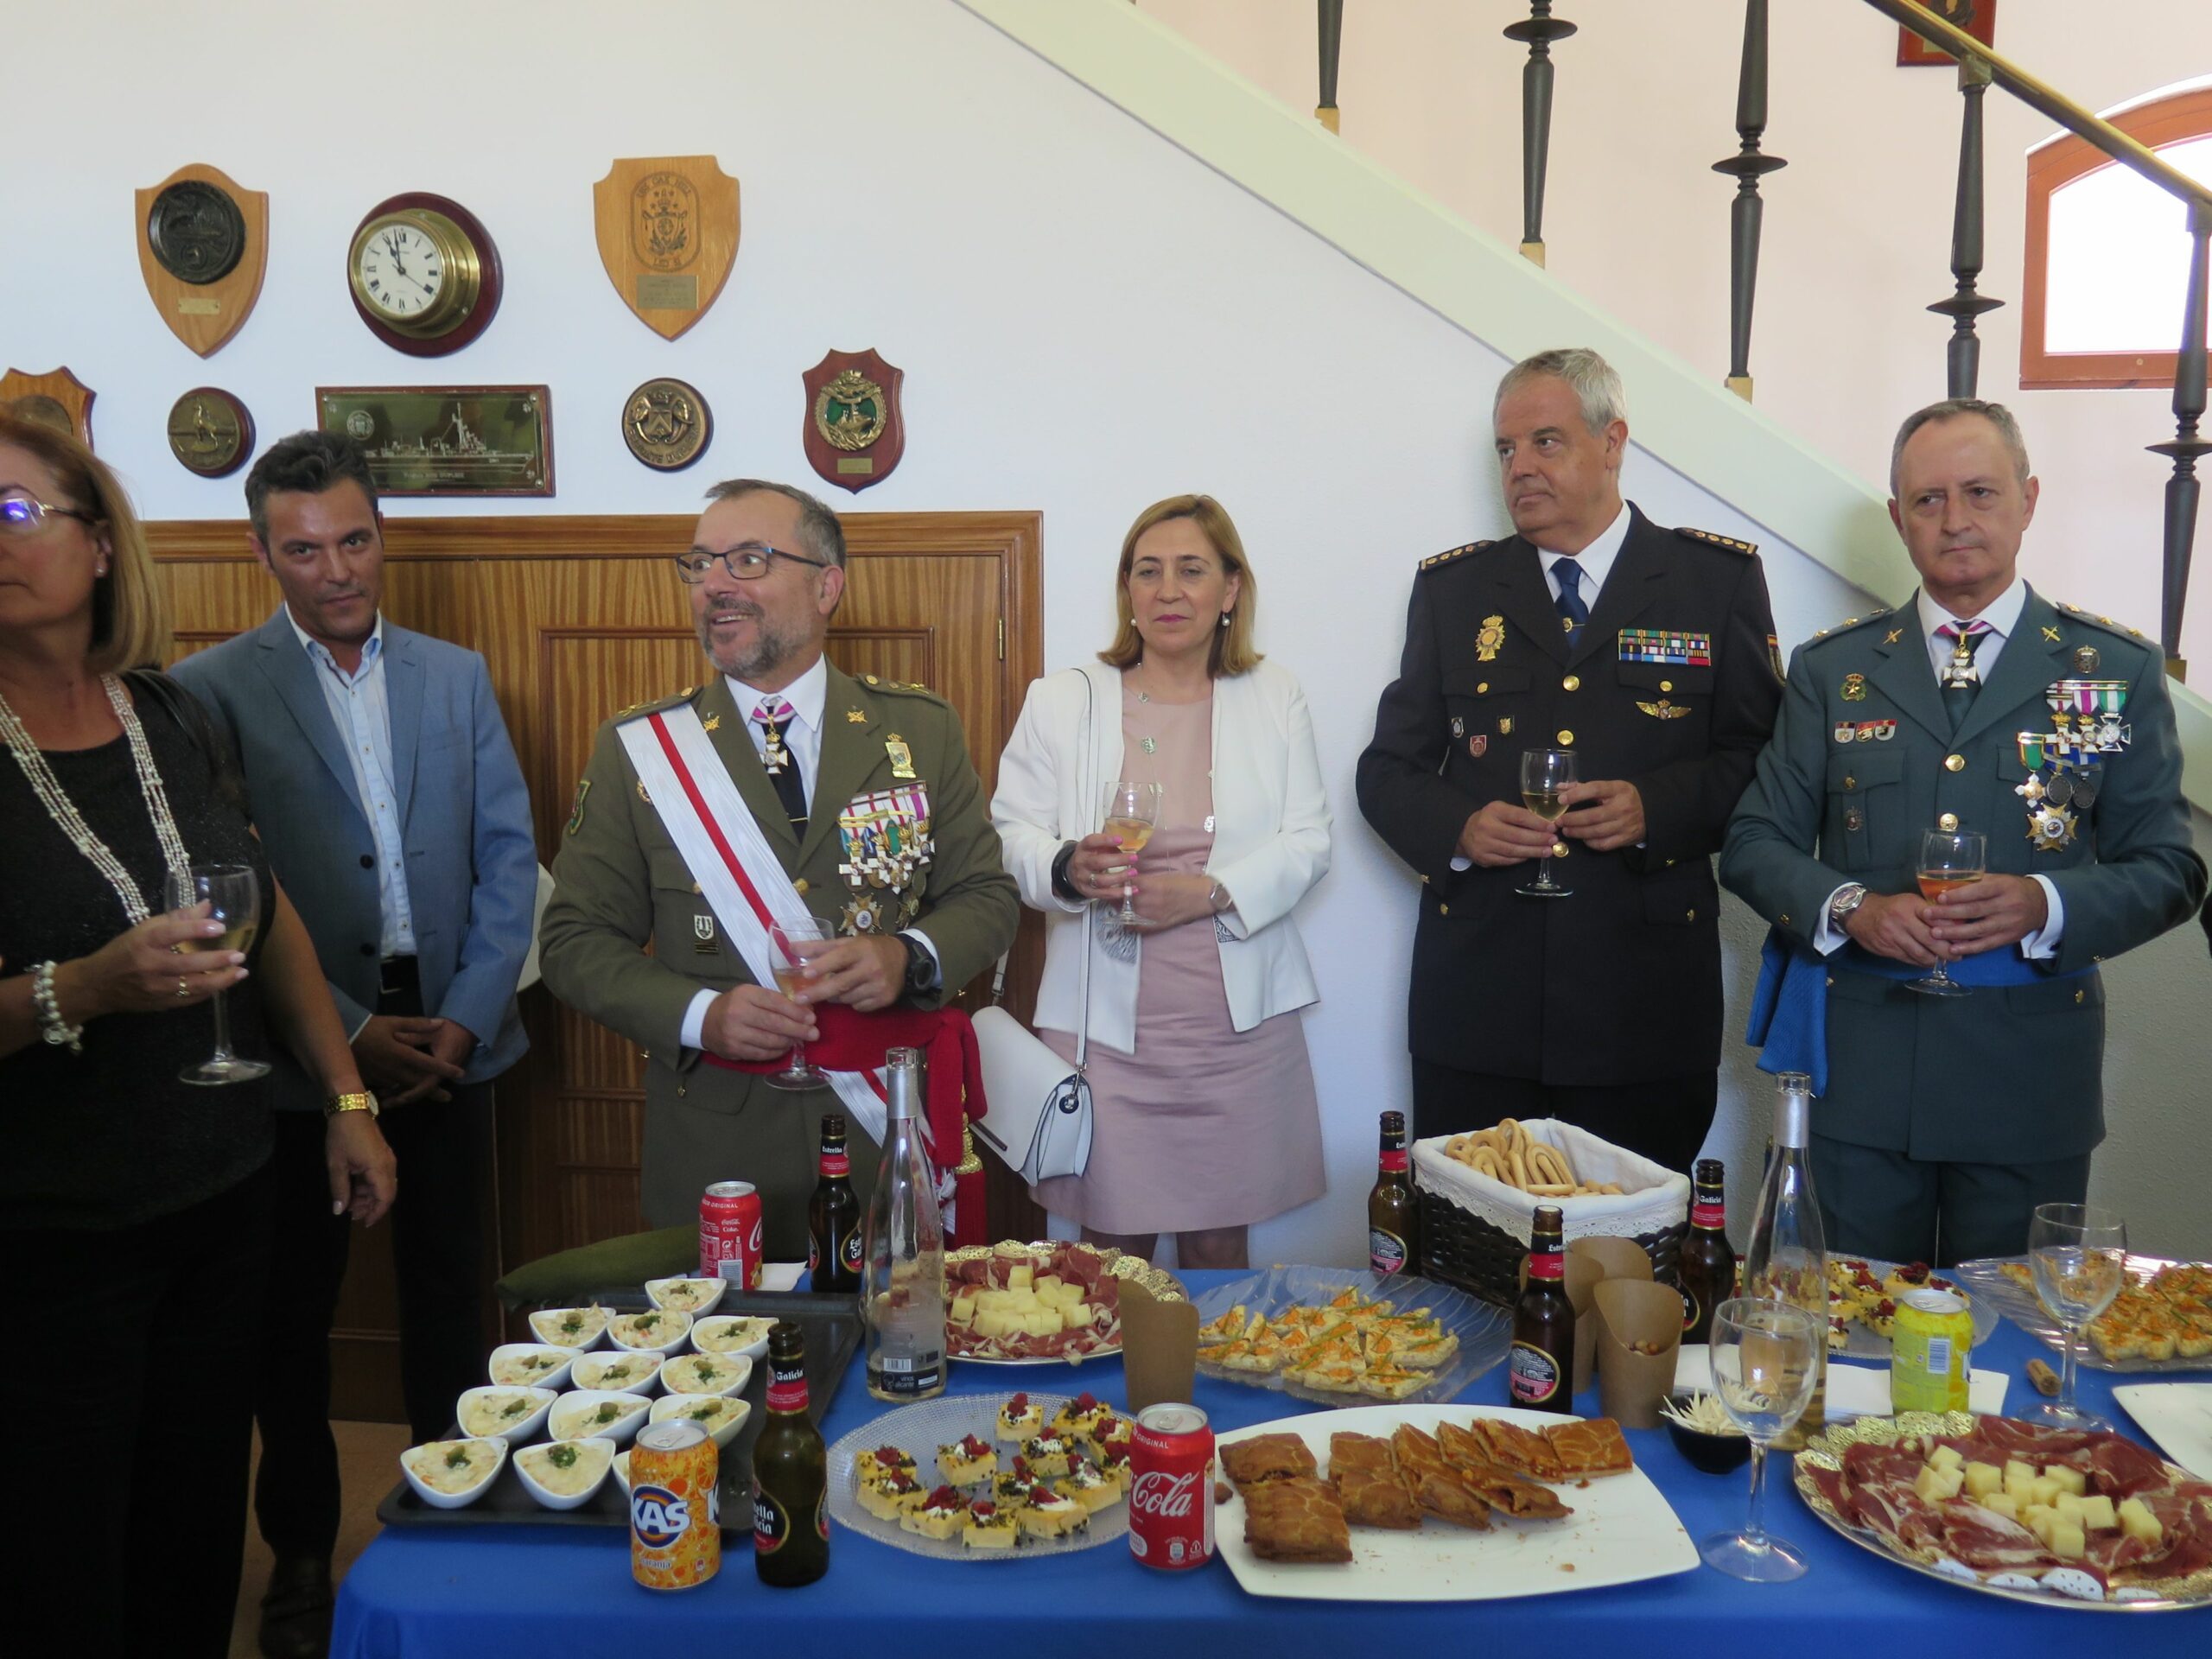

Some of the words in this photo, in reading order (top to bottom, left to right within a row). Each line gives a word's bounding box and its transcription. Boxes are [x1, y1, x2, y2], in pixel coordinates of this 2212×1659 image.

[776, 1368, 804, 1381] Galicia
[1136, 1434, 1169, 1449] ORIGINAL
[631, 1497, 690, 1534] KAS
